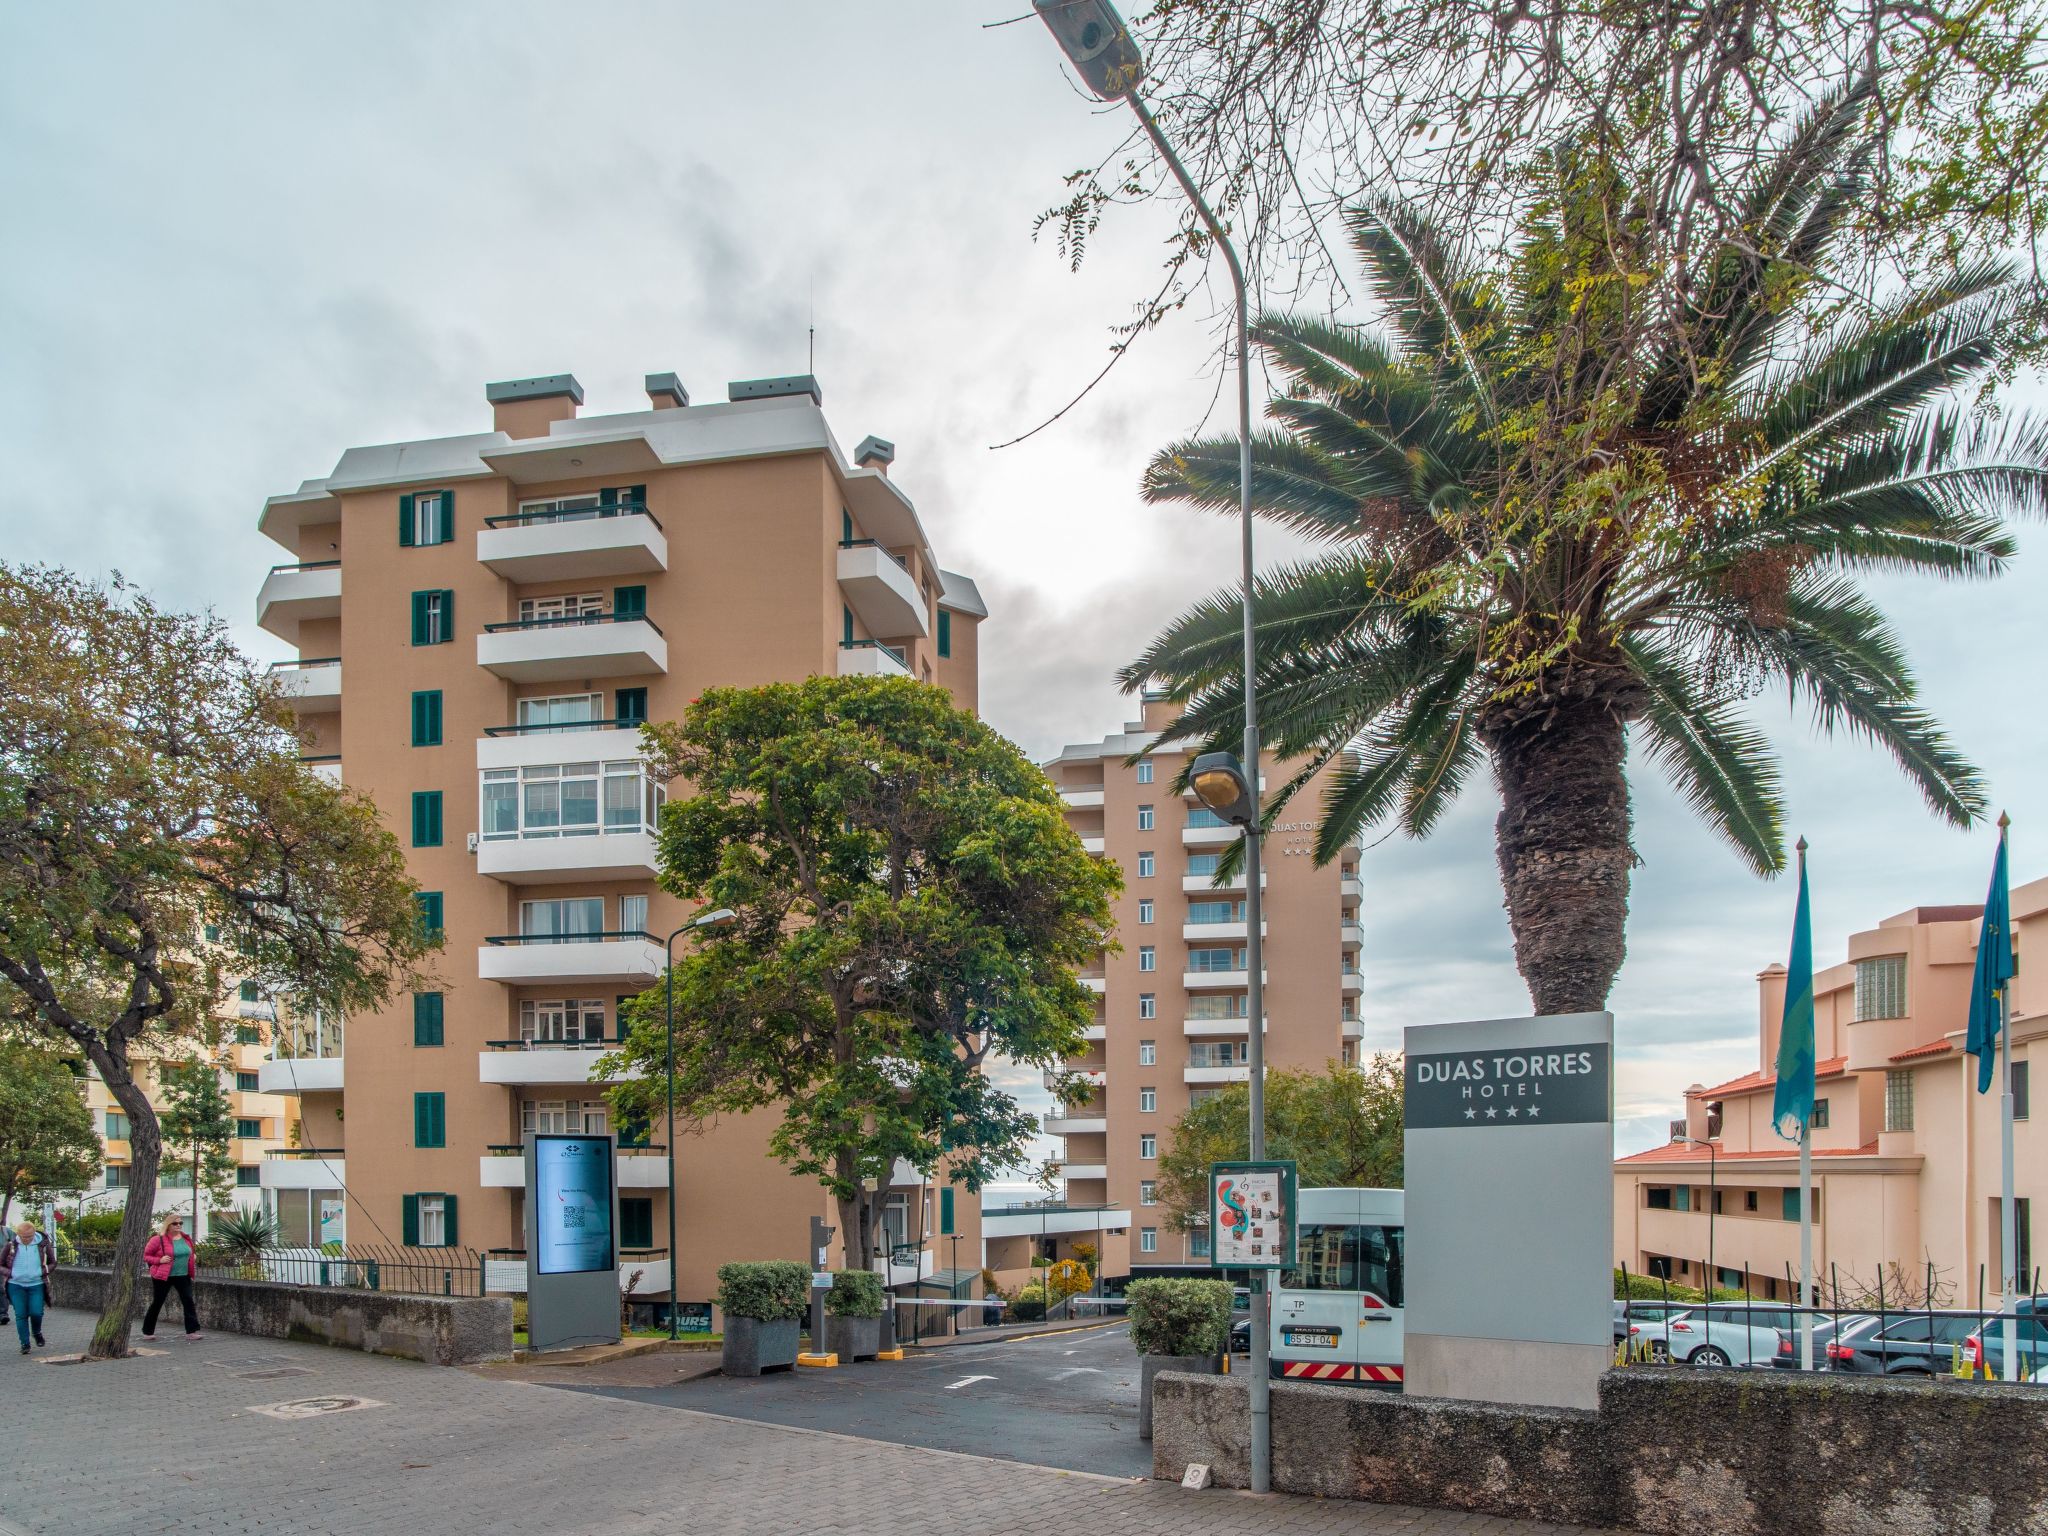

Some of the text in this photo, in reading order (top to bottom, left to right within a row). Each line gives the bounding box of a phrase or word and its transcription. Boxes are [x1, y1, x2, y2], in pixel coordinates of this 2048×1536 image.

[1271, 823, 1297, 832] DUAS
[1417, 1052, 1592, 1083] DUAS TORRES
[1462, 1082, 1542, 1099] HOTEL
[1293, 1300, 1304, 1308] TP
